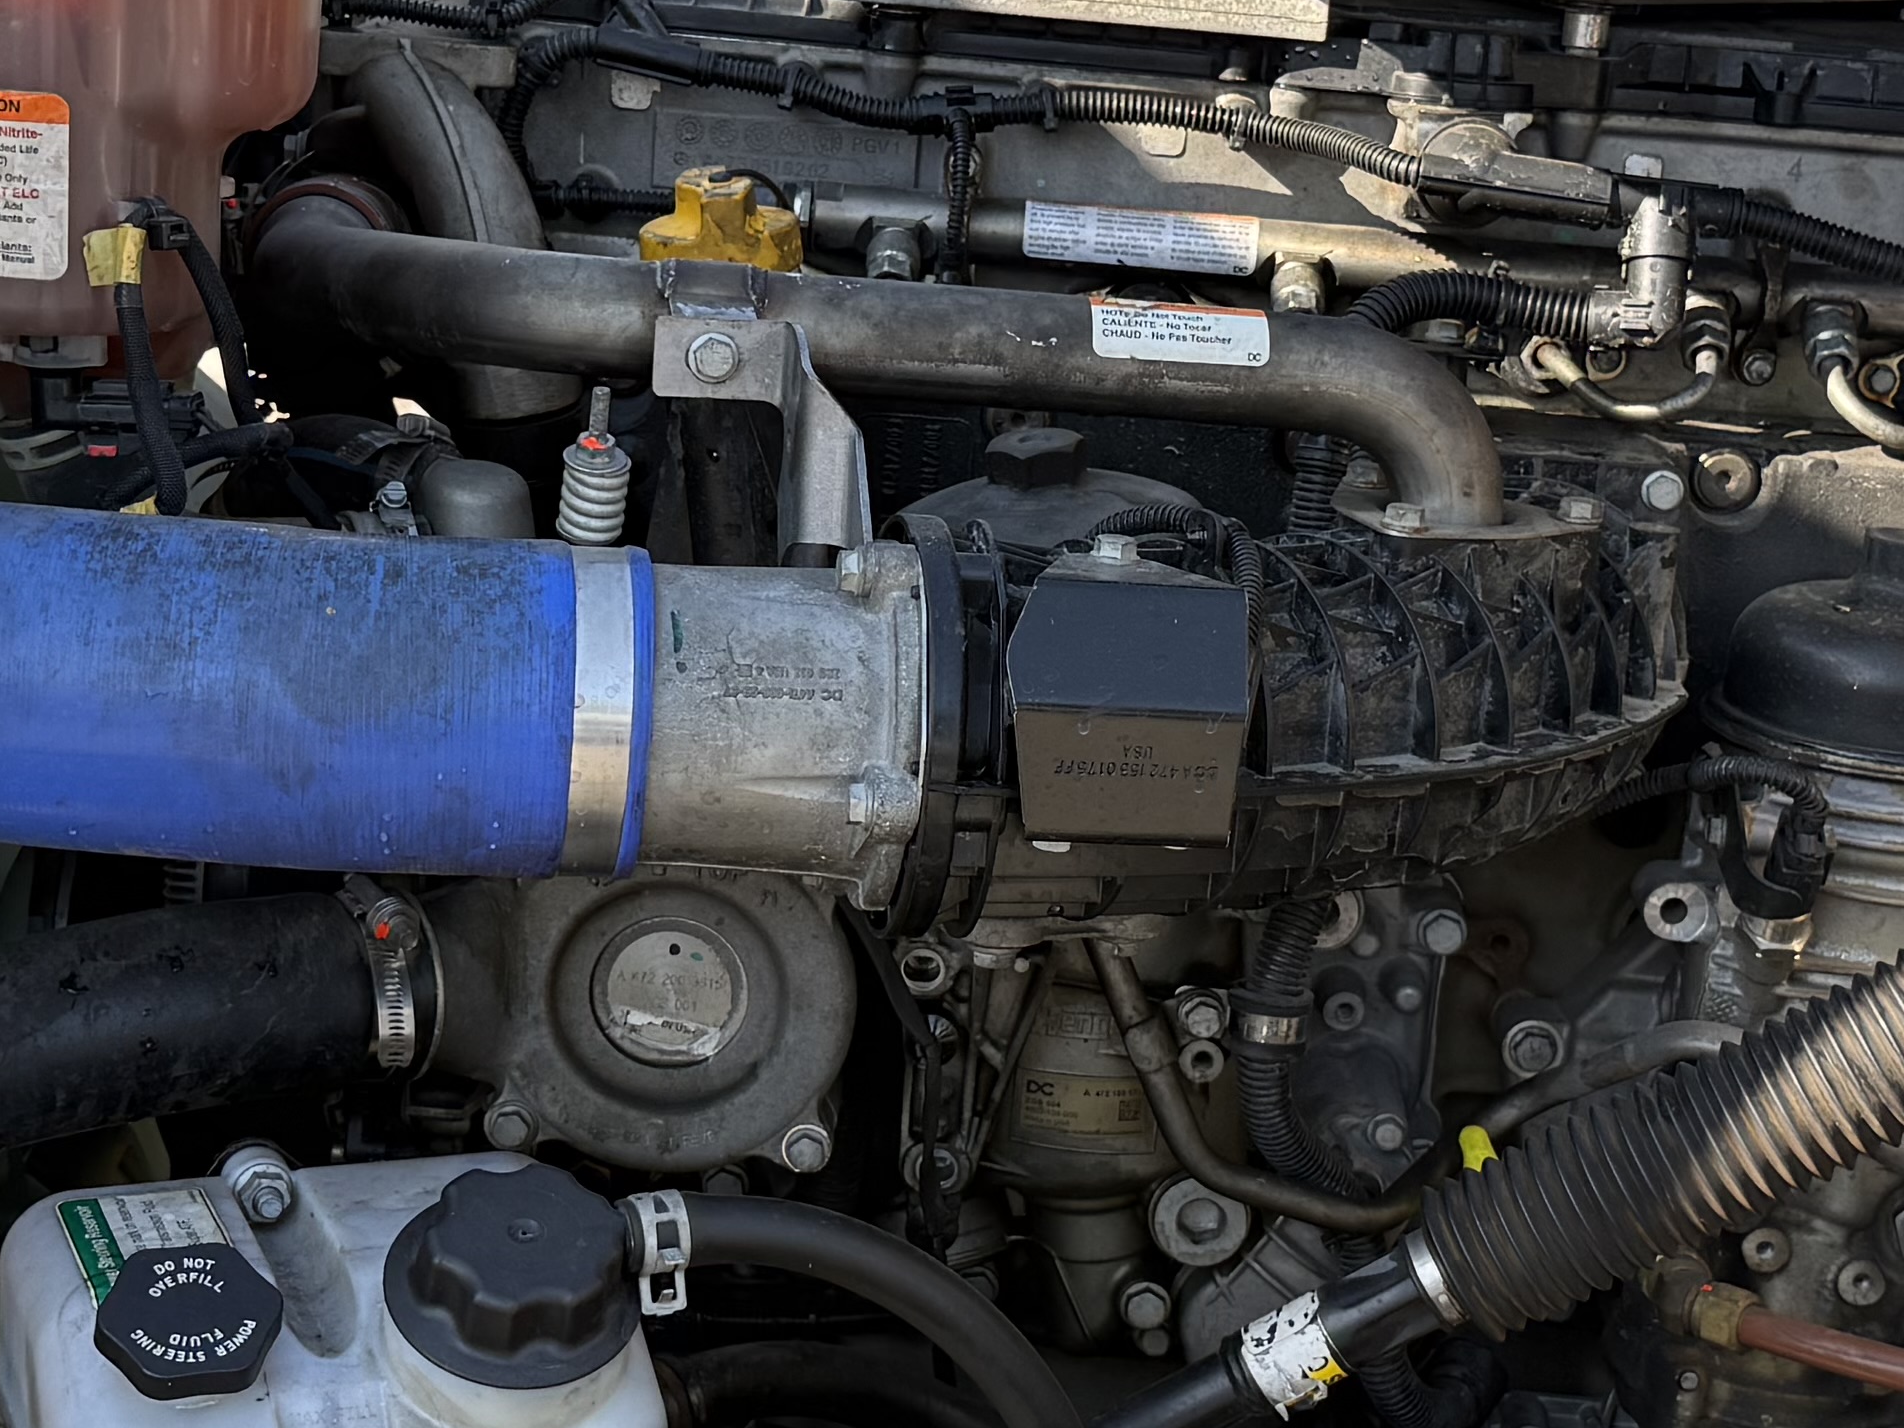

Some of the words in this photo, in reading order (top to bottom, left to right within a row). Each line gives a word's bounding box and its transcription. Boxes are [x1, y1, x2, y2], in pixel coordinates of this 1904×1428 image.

[5, 172, 28, 186] Only
[12, 187, 40, 199] ELC
[3, 202, 24, 212] Add
[25, 216, 37, 225] or
[1102, 318, 1156, 329] CALIENTE
[1102, 329, 1141, 339] CHAUD
[1247, 353, 1262, 362] DC
[1122, 745, 1153, 760] USA
[1149, 763, 1179, 779] 472
[1025, 1078, 1055, 1096] DC
[1083, 1088, 1091, 1097] A
[152, 1259, 177, 1276] DO
[183, 1257, 216, 1271] NOT
[148, 1272, 226, 1298] OVERFILL
[169, 1328, 225, 1347] FLUID
[214, 1319, 257, 1357] POWER
[130, 1329, 206, 1363] STEERING
